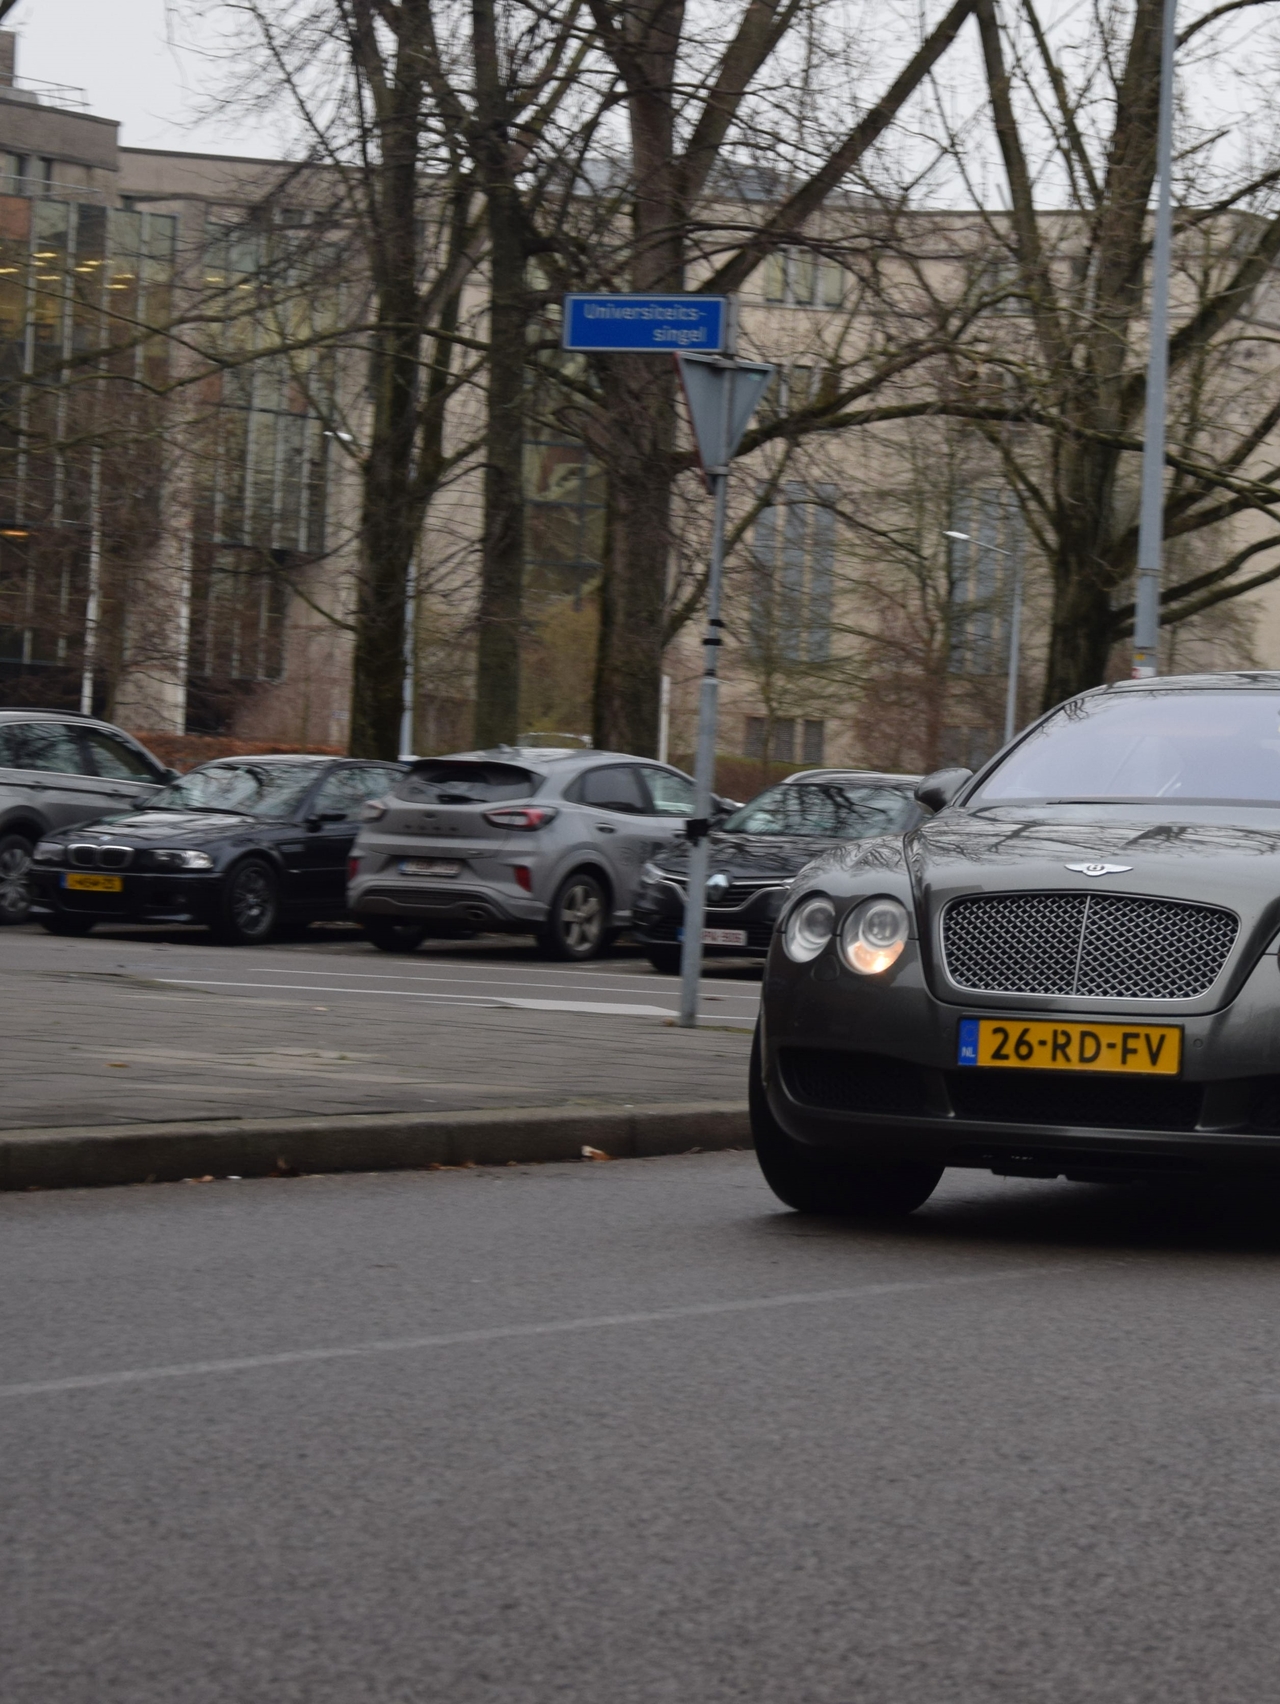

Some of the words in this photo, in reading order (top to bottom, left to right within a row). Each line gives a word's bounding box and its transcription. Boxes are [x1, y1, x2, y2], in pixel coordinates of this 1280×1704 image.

[583, 303, 707, 320] Universiteits-
[653, 325, 707, 345] singel
[961, 1046, 976, 1058] NL
[990, 1026, 1166, 1067] 26-RD-FV
